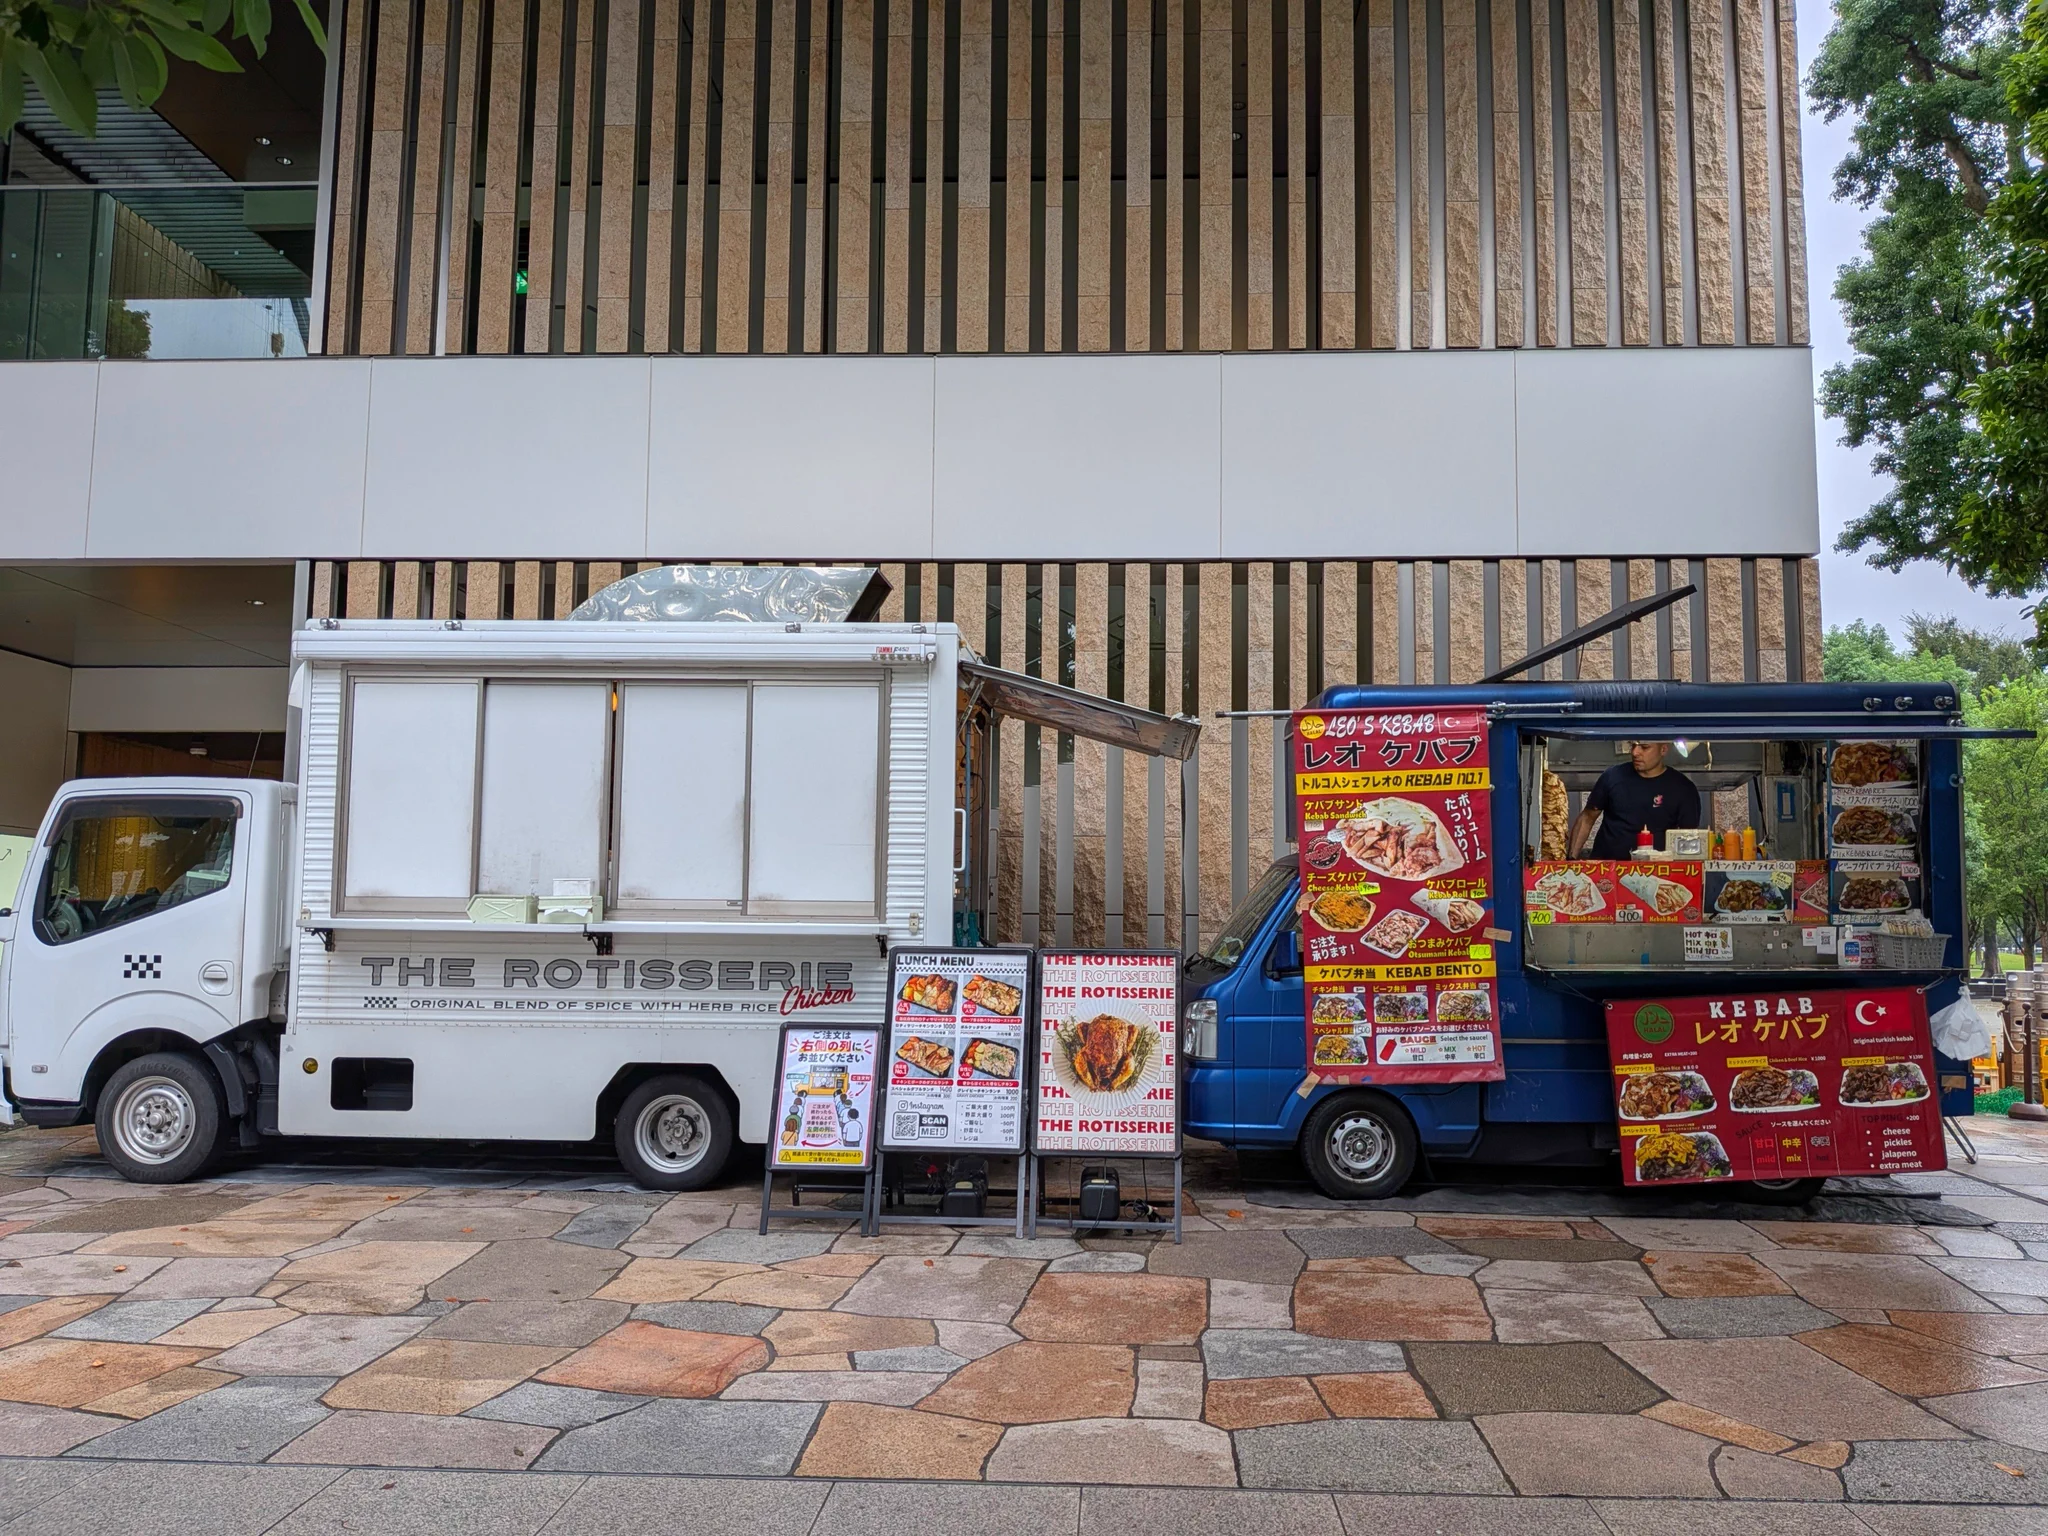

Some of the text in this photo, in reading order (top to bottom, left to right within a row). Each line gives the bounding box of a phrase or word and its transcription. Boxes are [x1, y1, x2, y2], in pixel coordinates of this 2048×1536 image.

[1378, 713, 1435, 736] KEBAB
[1304, 735, 1482, 769] レオ ケバブ
[1302, 775, 1402, 790] トルコ人シェフレオの
[1405, 773, 1453, 787] KEBAB
[1304, 799, 1363, 811] ケバブサンド
[1330, 811, 1367, 820] Sandwich
[1458, 792, 1487, 861] ボリューム
[1306, 872, 1487, 890] チーズケバブ ケバブロール
[1307, 884, 1334, 892] Cheese
[1428, 890, 1468, 899] Kebab Roll
[1531, 912, 1551, 923] 700
[1685, 931, 1702, 939] HOT
[1310, 935, 1337, 949] ご注文
[1408, 937, 1472, 949] おつまみケバブ
[1685, 939, 1702, 947] Mix
[1408, 949, 1447, 958] Otsumami
[1685, 947, 1703, 955] Mild
[897, 955, 974, 967] LUNCH MENU
[1045, 955, 1175, 966] THE ROTISSERIE
[361, 957, 854, 991] THE ROTISSERIE
[1043, 970, 1175, 983] THE ROTISSERIE
[1319, 963, 1482, 979] ケバブ弁当 KEBAB BENTO
[1373, 985, 1407, 993] ビーフ弁当
[1435, 982, 1476, 990] ミックス弁当
[1043, 987, 1175, 999] THE ROTISSERIE
[779, 983, 857, 1016] Chicken
[410, 999, 778, 1012] ORIGINAL BLEND OF SPICE WITH HERB RICE
[1709, 997, 1814, 1019] KEBAB
[1695, 1013, 1830, 1045] レオ ケバブ
[812, 1030, 851, 1040] ご注文は
[1400, 1035, 1437, 1044] SAUCE
[1896, 1035, 1914, 1043] kebab
[801, 1040, 862, 1052] 右側の列に
[798, 1053, 865, 1063] お並びください
[909, 1101, 944, 1112] Instagram
[1040, 1103, 1074, 1116] THE
[921, 1117, 946, 1125] SCAN
[1861, 1112, 1920, 1124] TOPPING +200
[1039, 1119, 1175, 1133] THE ROTISSERIE
[1735, 1119, 1763, 1139] SAUCE
[1882, 1127, 1911, 1136] cheese
[1039, 1136, 1175, 1151] THE ROTISSERIE
[1754, 1138, 1802, 1149] 甘口 中辛
[1884, 1138, 1912, 1149] pickles
[1756, 1154, 1776, 1164] mild
[1786, 1154, 1802, 1163] mix
[1881, 1149, 1917, 1160] jalapeno
[1879, 1160, 1922, 1169] extra meat
